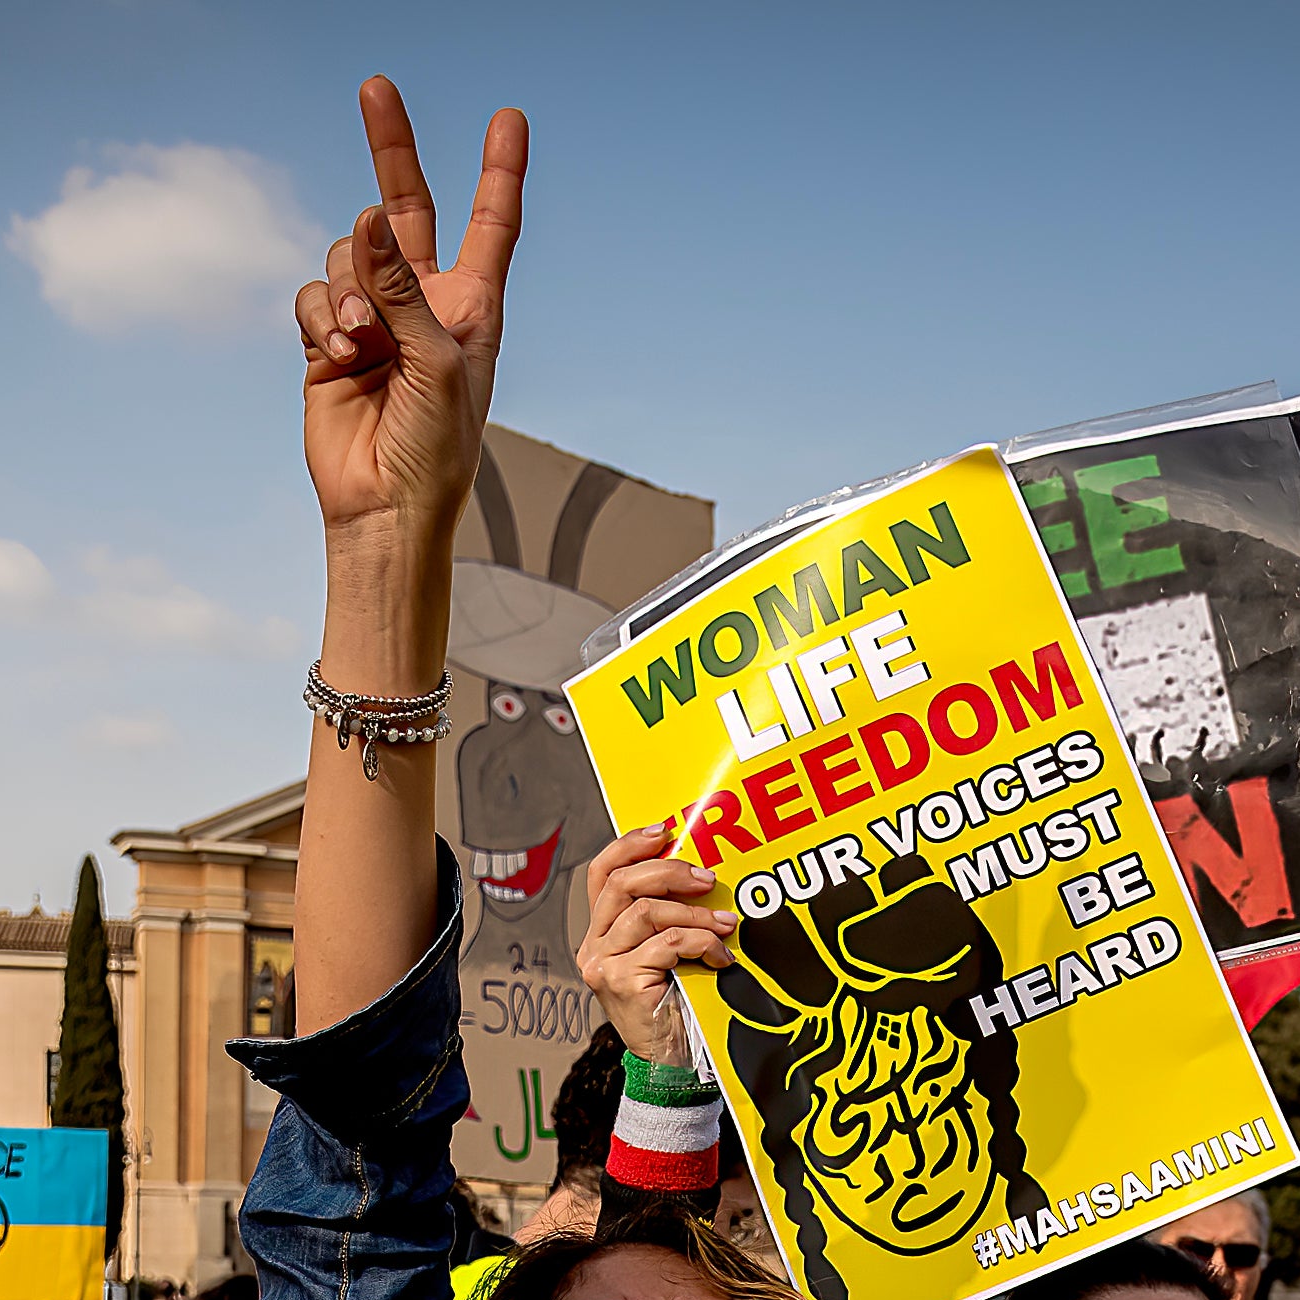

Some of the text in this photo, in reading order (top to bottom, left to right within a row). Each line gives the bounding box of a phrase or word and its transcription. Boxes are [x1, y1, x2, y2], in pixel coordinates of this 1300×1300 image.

[620, 501, 971, 728] WOMAN
[715, 609, 932, 763] LIFE
[735, 730, 1105, 921] OUR VOICES
[946, 787, 1121, 903] MUST
[1058, 852, 1154, 927] BE
[507, 944, 551, 976] 24
[967, 917, 1181, 1038] HEARD
[972, 1117, 1276, 1269] #MAHSAAMINI
